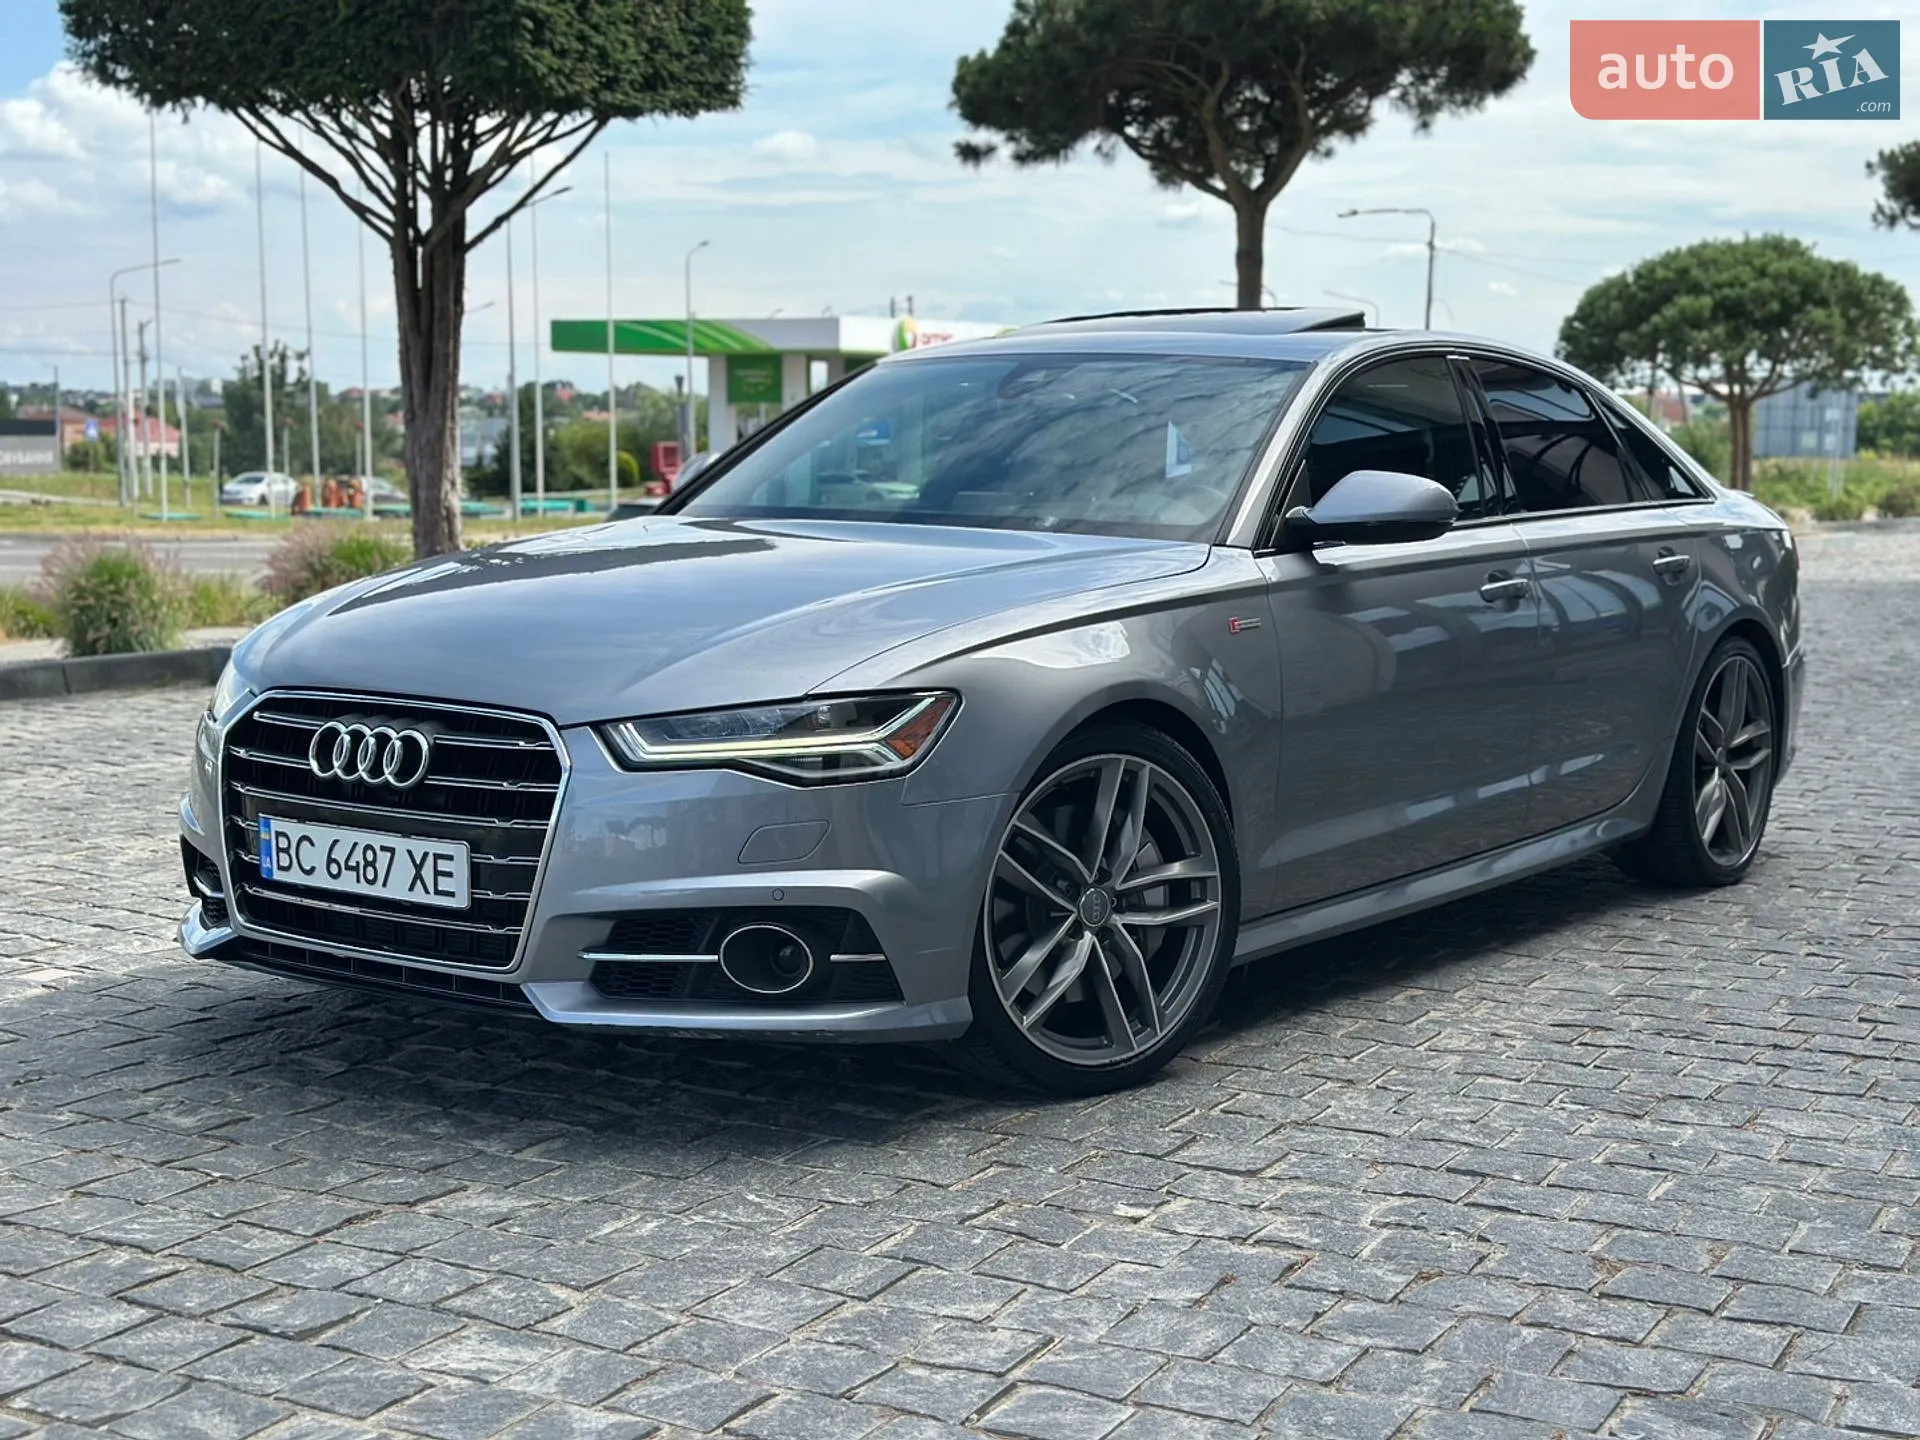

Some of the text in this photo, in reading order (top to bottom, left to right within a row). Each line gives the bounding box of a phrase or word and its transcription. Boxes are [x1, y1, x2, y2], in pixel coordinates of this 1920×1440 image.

[274, 830, 456, 898] BC 6487 XE
